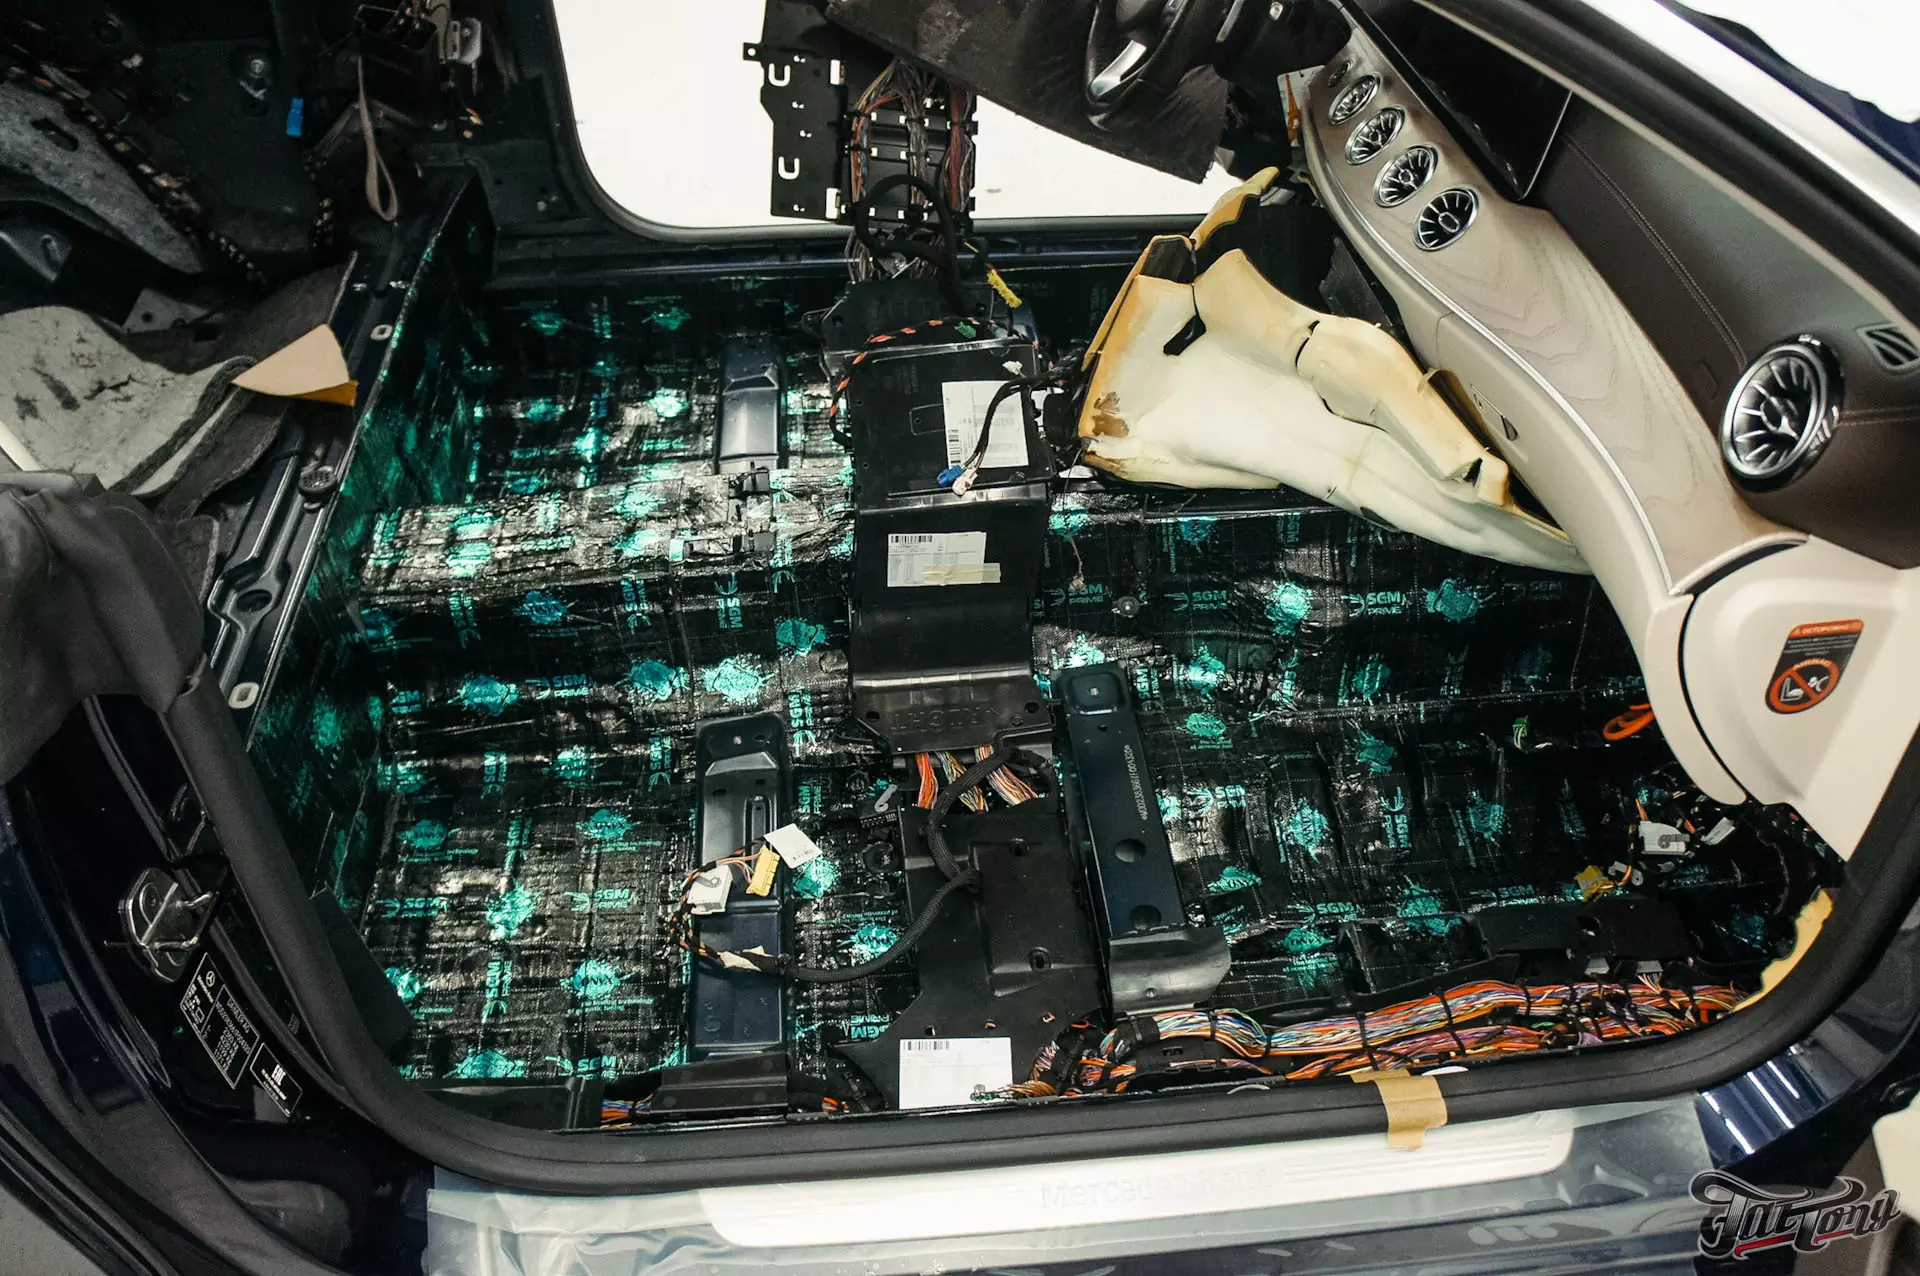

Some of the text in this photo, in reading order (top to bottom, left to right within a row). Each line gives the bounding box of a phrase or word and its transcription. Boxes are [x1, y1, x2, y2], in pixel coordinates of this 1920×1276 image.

[1191, 590, 1227, 602] SGM
[1367, 591, 1401, 604] SGM
[726, 598, 743, 629] SGM
[1368, 605, 1402, 615] PRIME
[553, 674, 587, 687] SGM
[554, 688, 589, 698] PRIME
[788, 694, 804, 728] SGM
[798, 785, 812, 814] SGM
[593, 889, 631, 900] SGM
[1316, 902, 1355, 914] SGM
[485, 961, 501, 998] SGM
[850, 1014, 890, 1025] PRIME
[577, 1055, 617, 1072] SGM
